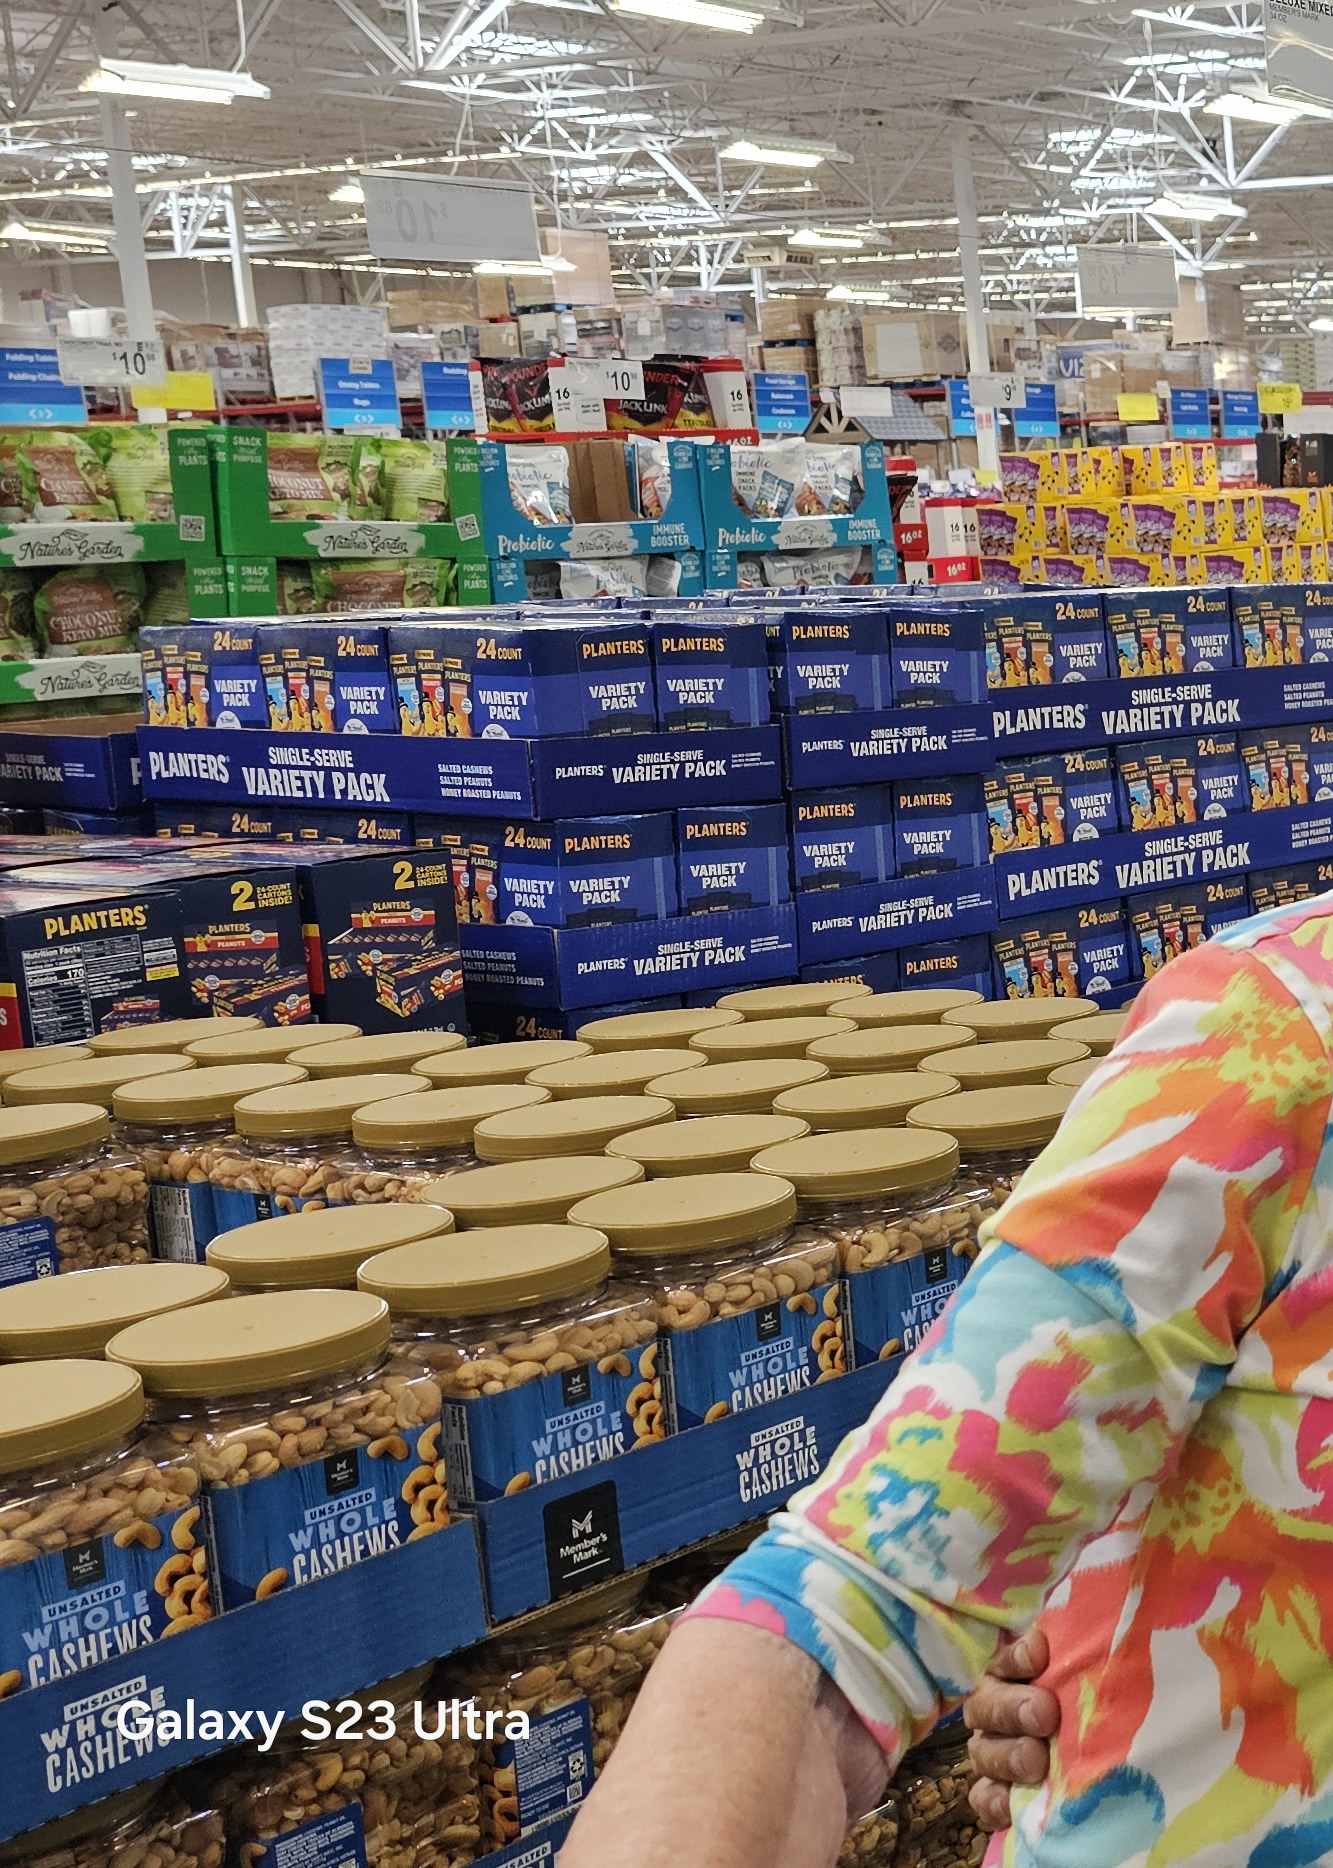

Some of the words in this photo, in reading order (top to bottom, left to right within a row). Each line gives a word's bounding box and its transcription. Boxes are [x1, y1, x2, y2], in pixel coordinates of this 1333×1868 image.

[1269, 3, 1301, 17] MEMBER'S
[1302, 12, 1320, 22] MARK
[555, 387, 570, 400] 16
[729, 390, 743, 401] 16
[616, 399, 638, 413] JACK
[232, 436, 262, 447] SNACK
[178, 455, 208, 466] PLANTS
[652, 523, 685, 535] IMMUNE
[848, 518, 877, 530] IMMUNE
[949, 522, 960, 533] 16
[963, 522, 976, 534] 16
[650, 534, 690, 548] BOOSTER
[718, 527, 767, 546] Probiotic
[847, 528, 882, 541] BOOSTER
[19, 542, 74, 561] Nature's
[78, 540, 125, 561] Garden
[323, 535, 367, 553] Nature's
[371, 536, 409, 554] Garden
[497, 533, 555, 556] Probiotic
[194, 584, 224, 595] PLANTS
[50, 610, 122, 631] CHOCONUT
[62, 630, 96, 643] KETO
[100, 625, 122, 638] MIX
[792, 625, 850, 640] PLANTERS
[476, 638, 497, 660] 24
[497, 647, 522, 661] COUNT
[583, 639, 645, 659] PLANTERS
[796, 663, 850, 678] VARIETY
[40, 675, 94, 695] Nature's
[588, 681, 646, 699] VARIETY
[808, 676, 841, 689] PACK
[478, 689, 528, 706] VARIETY
[601, 695, 638, 711] PACK
[1131, 683, 1212, 705] SINGLE-SERVE
[489, 705, 521, 721] PACK
[993, 705, 1086, 737] PLANTERS
[1101, 702, 1184, 735] VARIETY
[1190, 698, 1241, 726] PACK
[268, 747, 354, 768] SINGLE-SERVE
[637, 749, 704, 764] SINGLE-SERVE
[149, 751, 230, 784] PLANTERS
[437, 763, 461, 775] SALTED
[461, 765, 493, 775] CASHEWS
[555, 764, 604, 779] PLANTERS
[611, 761, 679, 784] VARIETY
[683, 759, 727, 778] PACK
[241, 766, 326, 799] VARIETY
[332, 771, 391, 803] PACK
[438, 776, 462, 786] SALTED
[464, 777, 493, 788] PEANUTS
[461, 788, 491, 799] ROASTED
[492, 790, 522, 801] PEANUTS
[231, 813, 249, 833] 24
[250, 821, 272, 834] COUNT
[392, 860, 415, 890] 2
[1007, 863, 1100, 901] PLANTERS
[230, 880, 255, 912] 2
[256, 882, 291, 894] 24-COUNT
[257, 889, 293, 900] CARTONS
[258, 896, 293, 908] INSIDE!
[44, 905, 147, 940] PLANTERS
[208, 923, 250, 935] PLANTERS
[23, 947, 58, 960] Nutrition
[59, 945, 82, 955] Facts
[217, 940, 246, 949] PEANUTS
[577, 958, 626, 975] PLANTERS
[632, 951, 701, 977] VARIETY
[27, 975, 58, 985] Calories
[66, 968, 84, 979] 170
[915, 1283, 957, 1303] UNSALTED
[744, 1340, 791, 1363] UNSALTED
[728, 1346, 809, 1389] WHOLE
[731, 1366, 811, 1414] CASHEWS
[549, 1404, 603, 1429] UNSALTED
[531, 1410, 623, 1458] WHOLE
[754, 1420, 801, 1443] UNSALTED
[735, 1425, 816, 1471] WHOLE
[535, 1431, 625, 1485] CASHEWS
[739, 1444, 820, 1503] CASHEWS
[309, 1492, 373, 1521] UNSALTED
[288, 1497, 397, 1553] WHOLE
[292, 1520, 401, 1586] CASHEWS
[559, 1532, 608, 1559] Member's
[573, 1546, 599, 1565] Mark
[48, 1585, 121, 1617] UNSALTED
[21, 1589, 150, 1652] WHOLE
[27, 1614, 154, 1689] CASHEWS
[69, 1680, 142, 1716] UNSALTED
